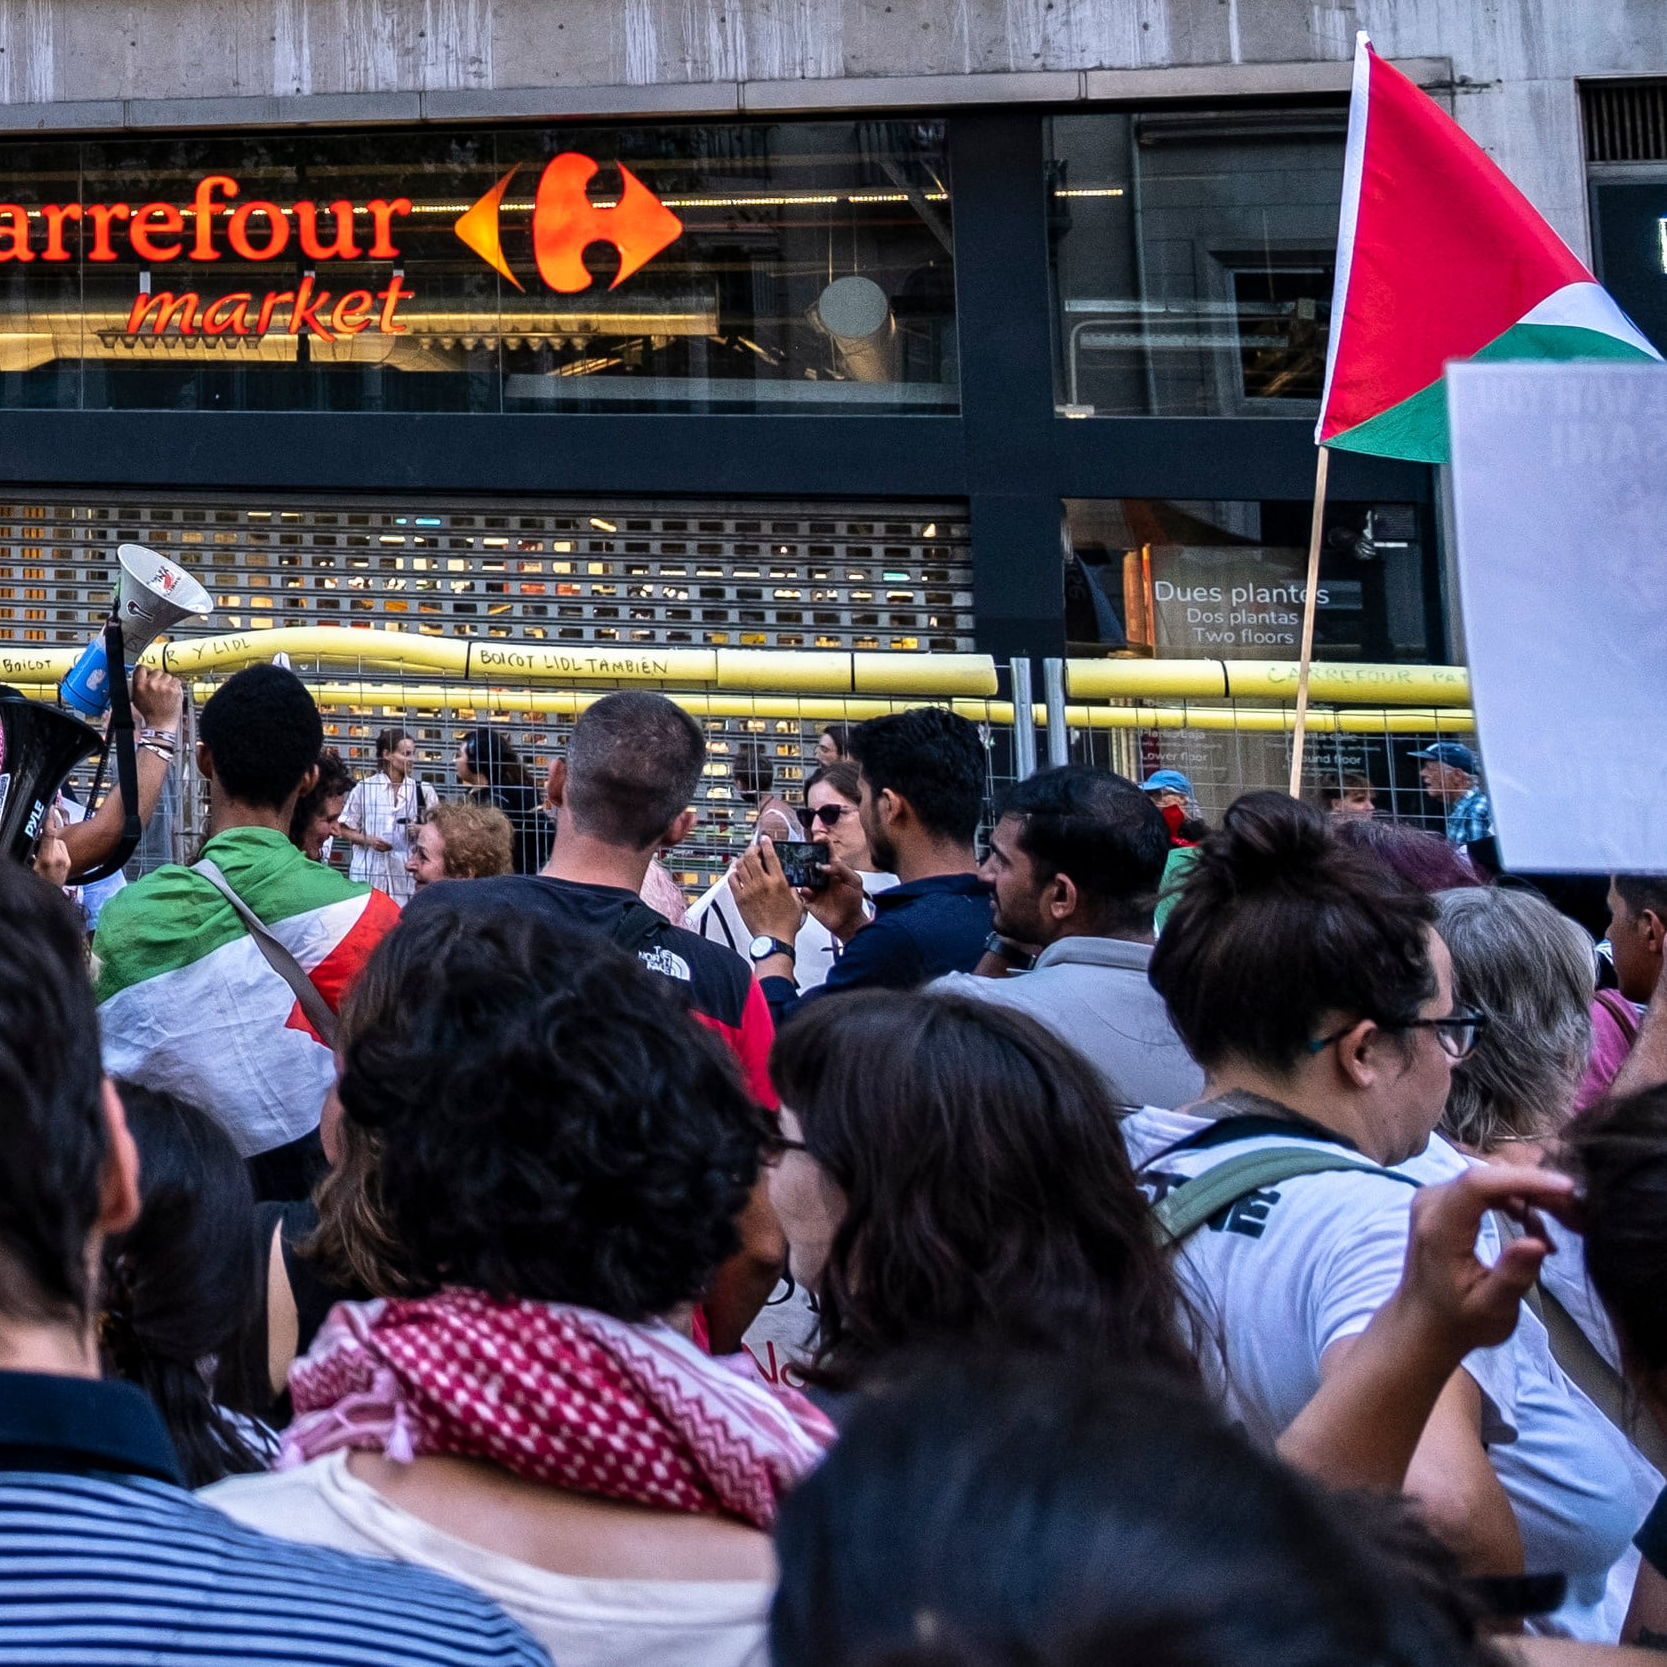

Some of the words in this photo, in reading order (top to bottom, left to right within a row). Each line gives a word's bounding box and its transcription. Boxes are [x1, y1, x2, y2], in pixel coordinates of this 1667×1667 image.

[126, 274, 416, 344] market
[1154, 580, 1222, 603] Dues
[1186, 608, 1225, 624] Dos
[1229, 608, 1299, 627] plantas
[213, 637, 251, 655] LIDL
[1193, 627, 1236, 644] Two
[1240, 627, 1295, 645] floors
[479, 649, 536, 669] BOICOT
[543, 653, 584, 672] LIDL
[24, 798, 45, 838] PYLE
